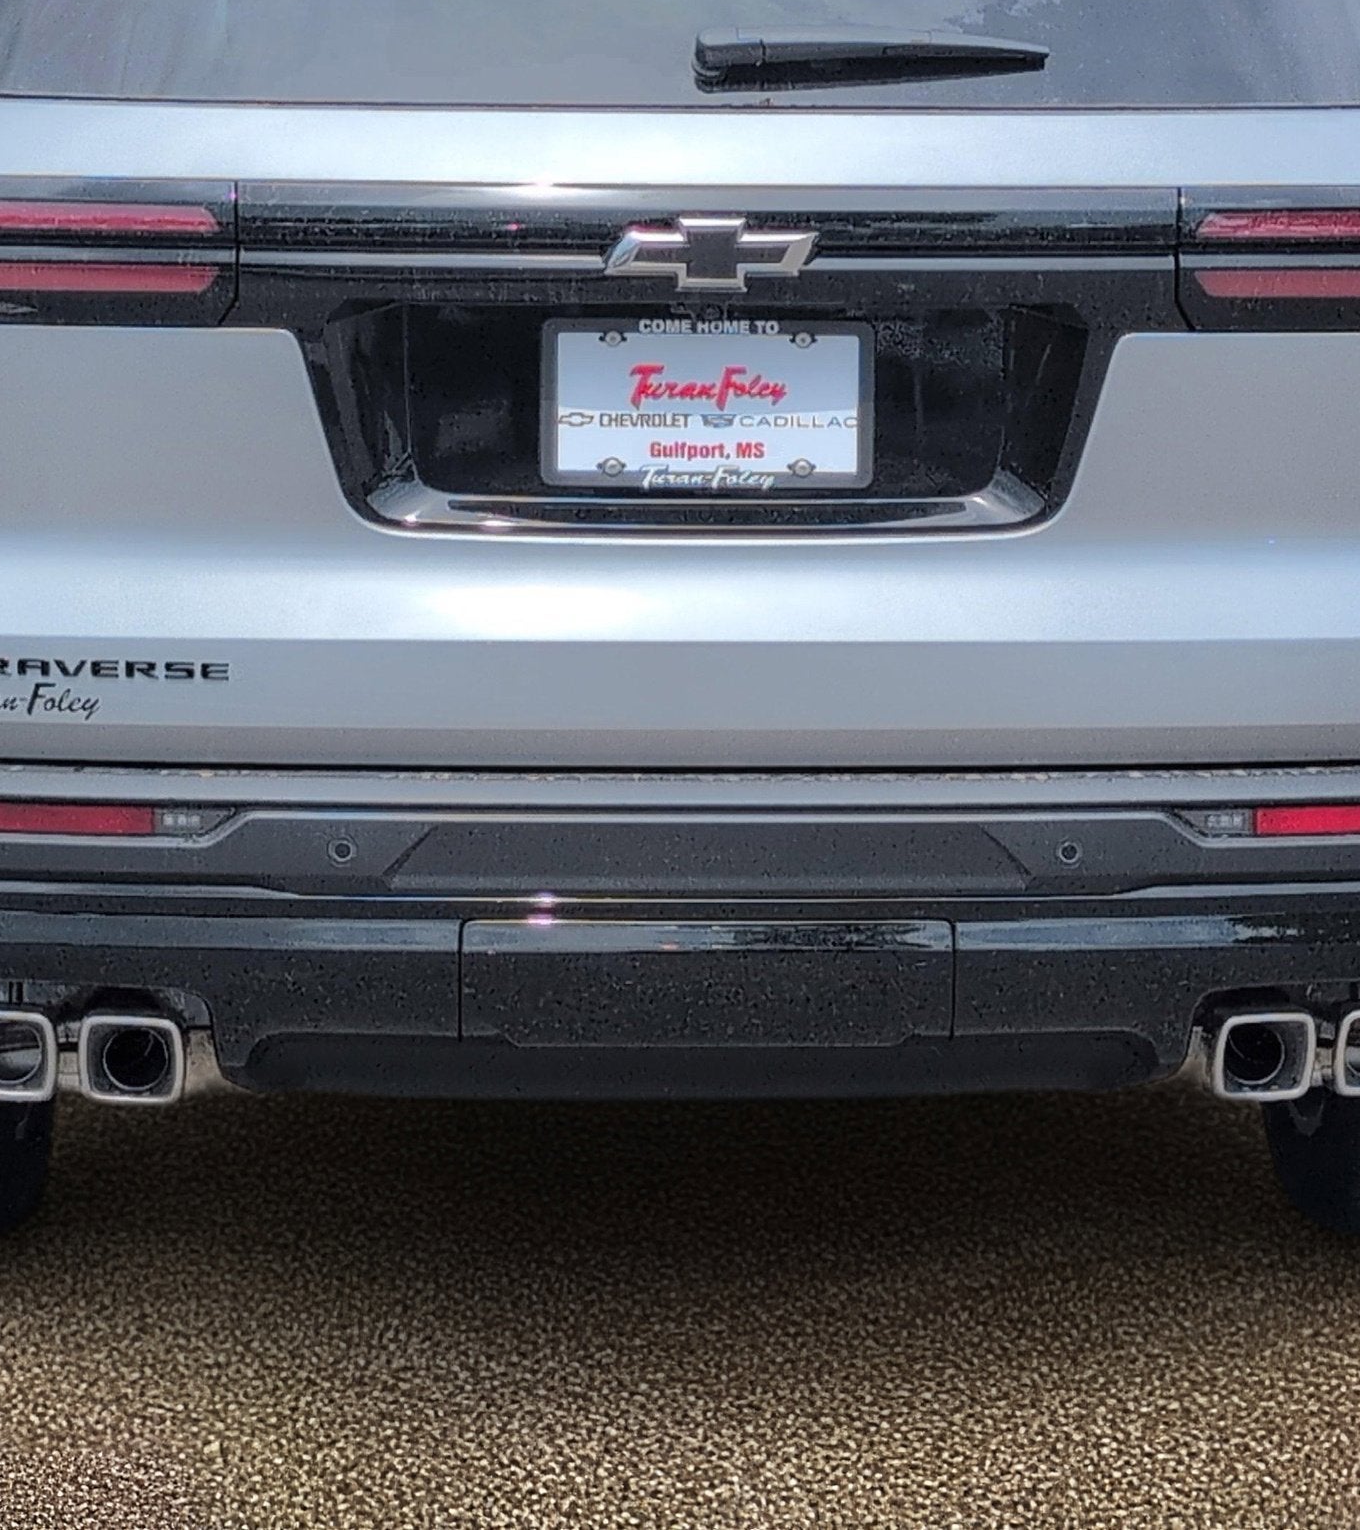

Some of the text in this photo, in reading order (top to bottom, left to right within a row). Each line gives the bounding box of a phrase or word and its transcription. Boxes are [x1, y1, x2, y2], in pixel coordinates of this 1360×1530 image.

[638, 319, 780, 335] COME HOME TO
[599, 412, 690, 429] CHEVROLET
[739, 414, 859, 429] CADILLAC
[649, 441, 765, 461] Gulfport, MS
